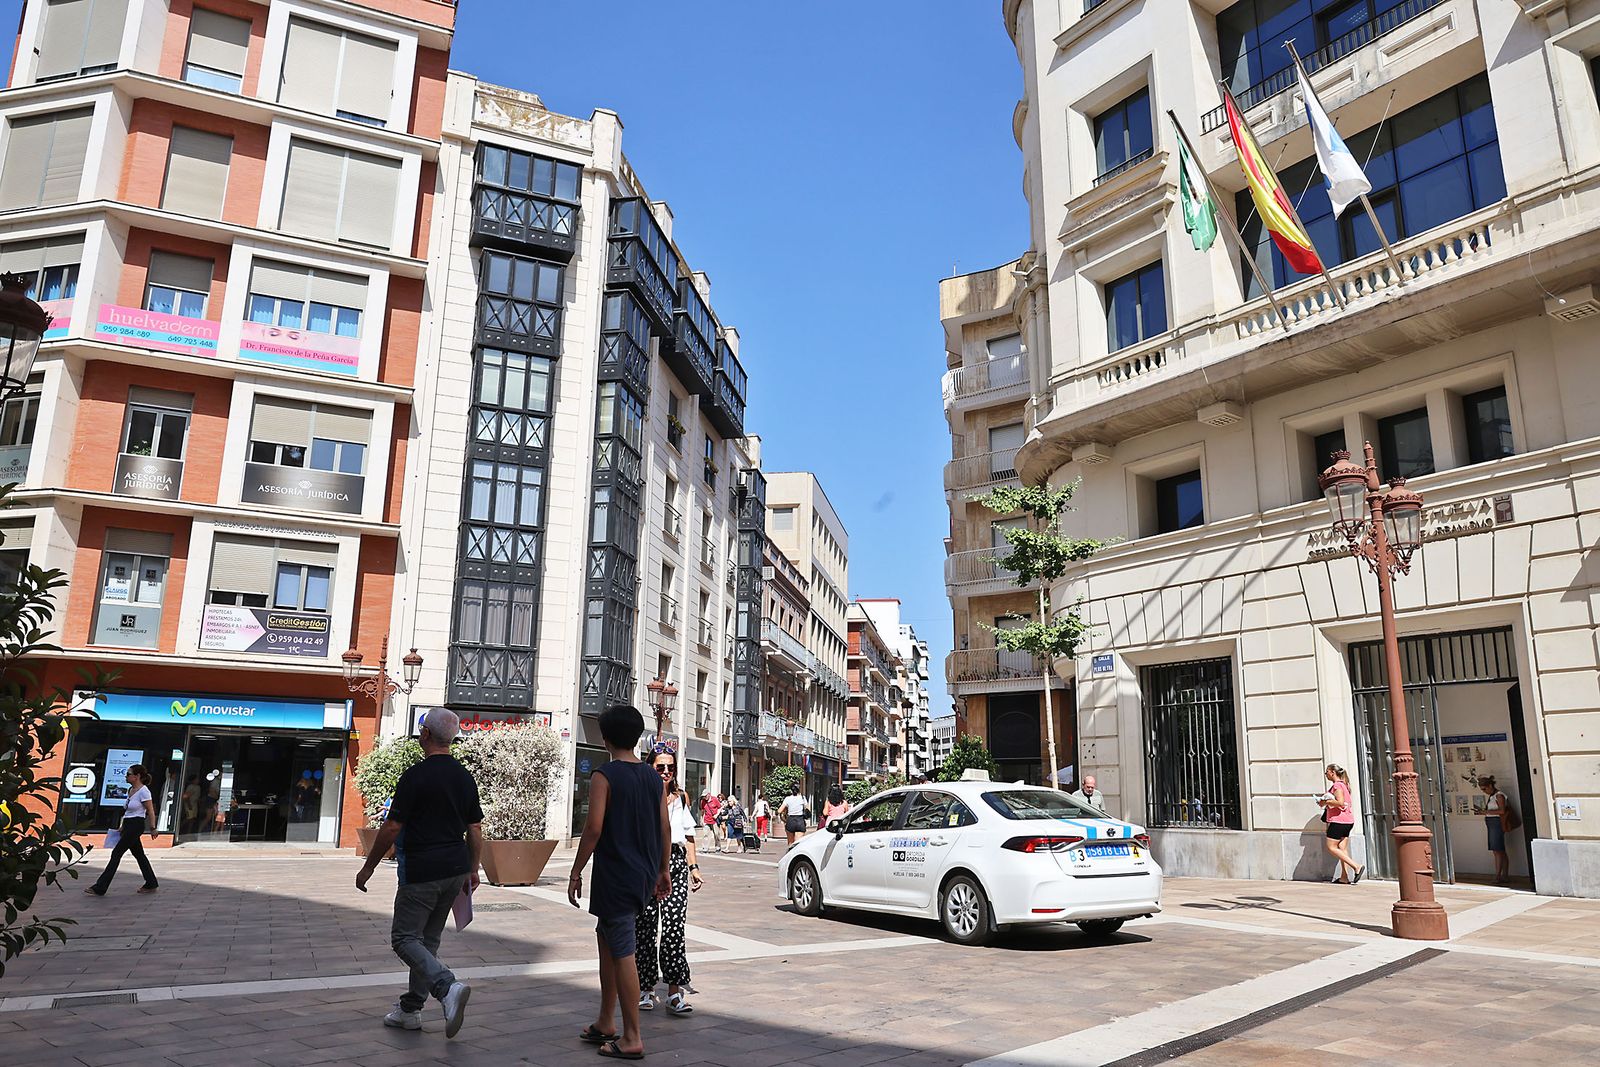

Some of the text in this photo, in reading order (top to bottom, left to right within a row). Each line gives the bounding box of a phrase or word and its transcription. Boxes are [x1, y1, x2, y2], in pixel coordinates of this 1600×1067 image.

[109, 308, 213, 337] huelvaderm
[103, 325, 117, 333] 959
[120, 327, 134, 335] 284
[260, 345, 294, 355] Francisco
[304, 350, 311, 358] la
[313, 352, 330, 361] Peña
[124, 472, 172, 484] ASESORÍA
[124, 479, 169, 491] JURÍDICA
[258, 484, 349, 501] ASESORÍA JURÍDICA
[269, 616, 326, 627] CreditGestión
[278, 635, 324, 646] 959 04 42 49
[200, 704, 256, 716] movistar
[1077, 849, 1085, 862] 3
[1090, 846, 1113, 856] 5818
